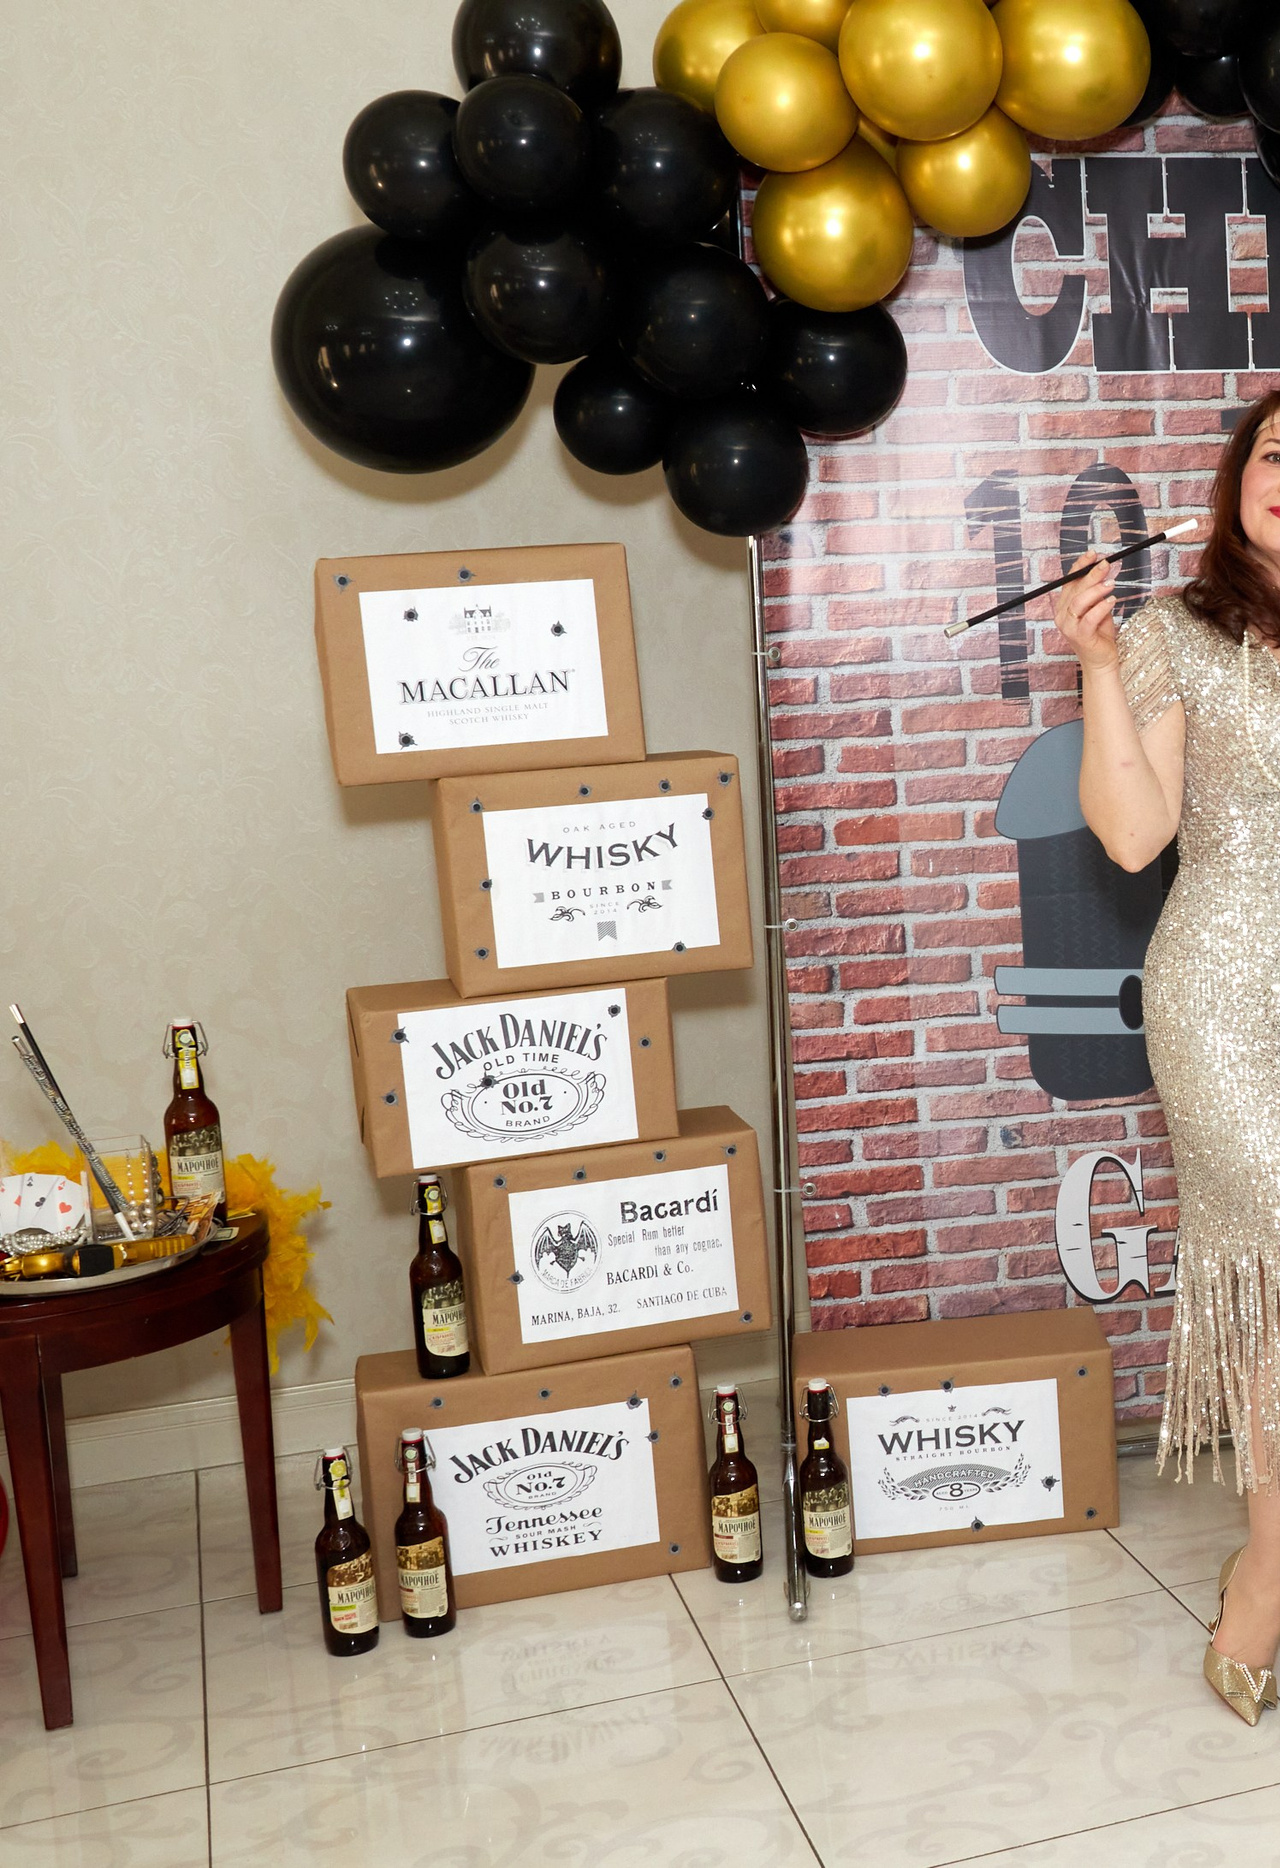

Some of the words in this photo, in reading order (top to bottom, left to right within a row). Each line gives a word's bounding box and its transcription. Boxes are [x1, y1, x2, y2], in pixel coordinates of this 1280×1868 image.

[458, 645, 501, 672] The
[398, 669, 569, 704] MACALLAN
[427, 707, 481, 718] HIGHLAND
[485, 705, 520, 714] SINGLE
[524, 702, 549, 711] MALT
[449, 716, 489, 726] SCOTCH
[492, 713, 529, 723] WHISKY
[562, 824, 590, 834] OAK
[599, 820, 636, 830] AGED
[526, 822, 679, 870] WHISKY
[551, 881, 656, 900] BOURBON
[431, 1025, 501, 1081] JACK
[499, 1012, 608, 1062] DANIEL'S
[482, 1054, 515, 1072] OLD
[522, 1052, 560, 1064] TIME
[502, 1079, 546, 1100] Old
[505, 1115, 551, 1128] BRAND
[177, 1157, 219, 1173] МАРОЧНОЕ
[620, 1188, 718, 1224] Bacardí
[607, 1230, 635, 1247] Special
[641, 1228, 659, 1242] Rum
[662, 1224, 685, 1239] better
[654, 1243, 671, 1257] than
[675, 1242, 689, 1256] any
[606, 1264, 658, 1285] BACARDI
[663, 1263, 672, 1276] &
[636, 1292, 684, 1309] SANTIAGO
[687, 1290, 699, 1301] DE
[702, 1286, 728, 1298] CUBA
[531, 1312, 574, 1326] MARINA,
[877, 1419, 1025, 1455] WHISKY
[448, 1438, 520, 1484] JACK
[520, 1427, 630, 1461] DANIEL'S
[895, 1451, 953, 1462] STRAIGHT
[959, 1445, 1011, 1455] BOURBON
[526, 1470, 552, 1481] Old
[913, 1468, 996, 1488] HANDCRAFTED
[528, 1491, 557, 1500] BRAND
[949, 1482, 964, 1497] 8
[485, 1507, 603, 1535] Tennessee
[718, 1519, 756, 1534] МАРОЧНОЕ
[808, 1512, 847, 1527] МАРОЧНОЕ
[515, 1530, 543, 1539] SOUR
[547, 1525, 577, 1535] MASH
[489, 1529, 603, 1557] WHISKEY
